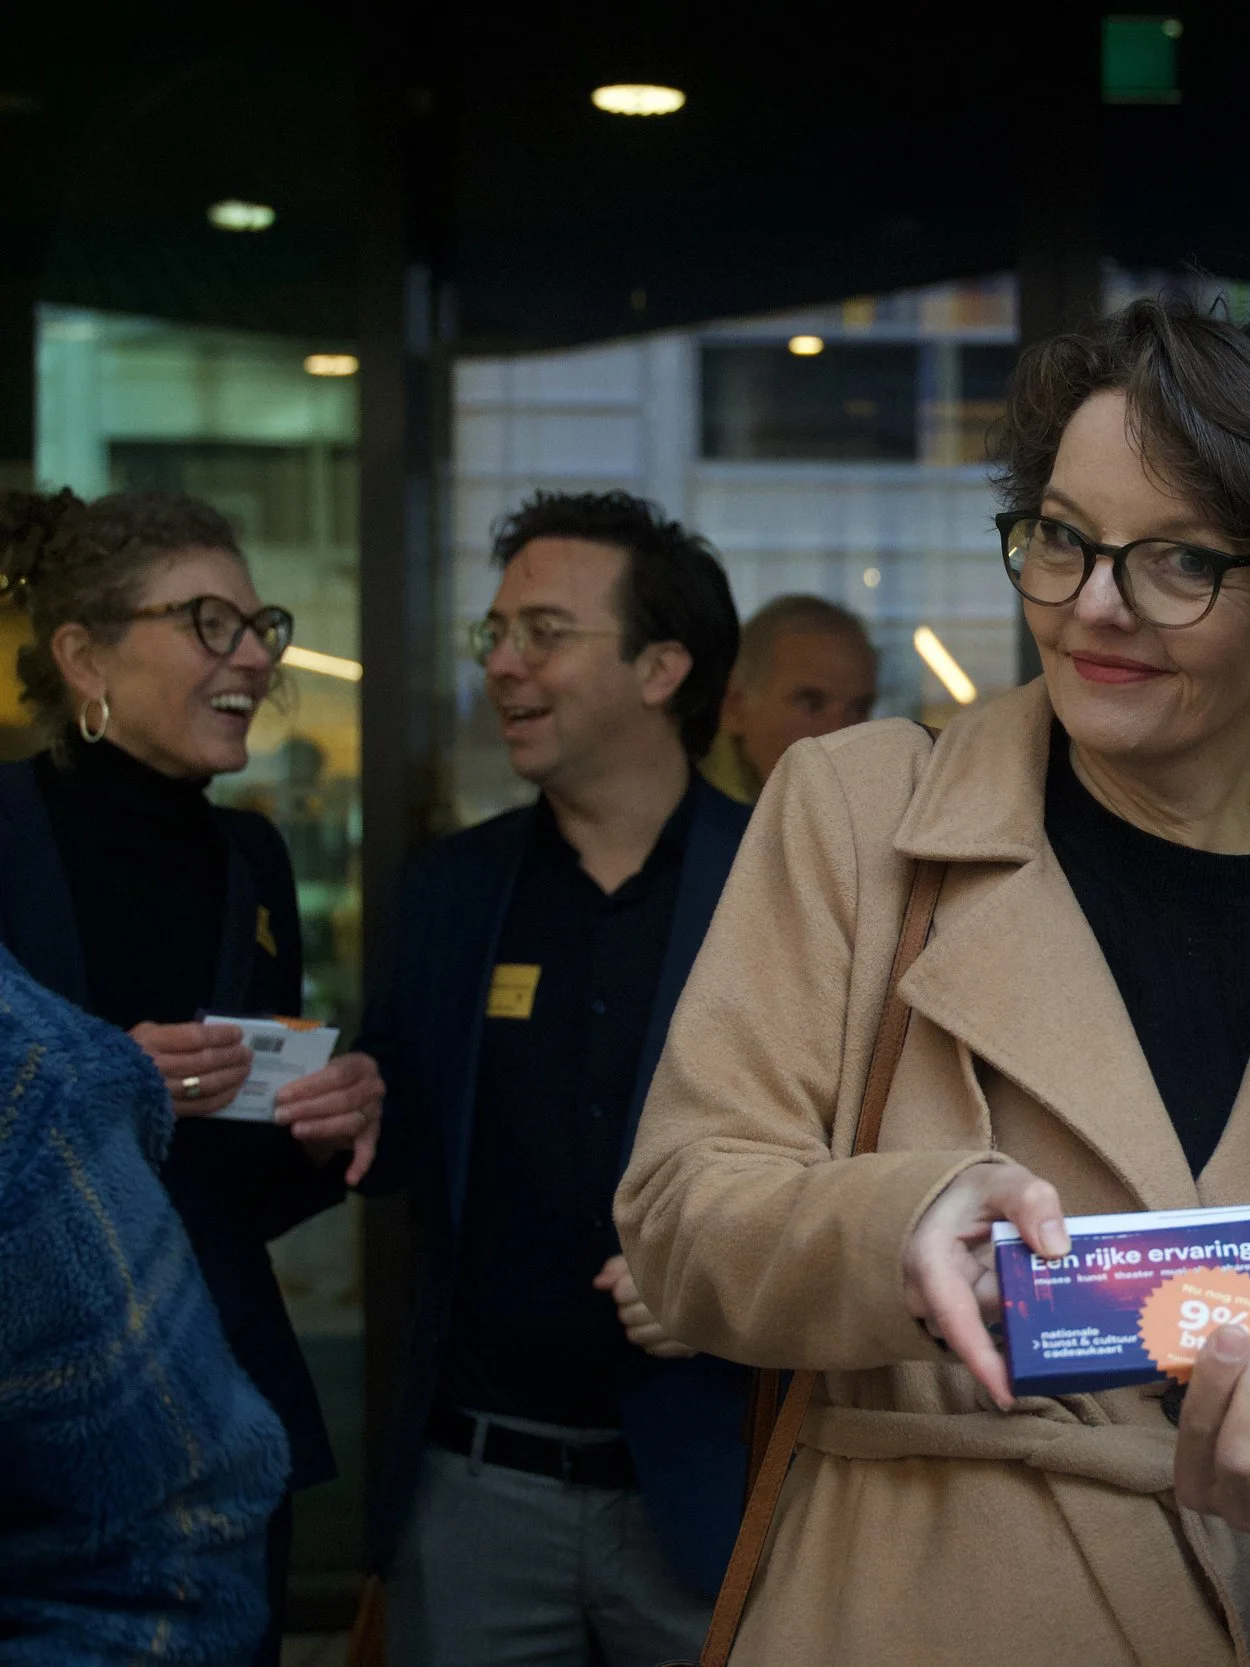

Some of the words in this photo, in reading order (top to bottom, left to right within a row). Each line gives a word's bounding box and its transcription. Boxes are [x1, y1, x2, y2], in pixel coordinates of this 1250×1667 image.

[1085, 1246, 1142, 1271] rijke
[1113, 1268, 1155, 1281] theater
[1203, 1289, 1232, 1305] nog
[1040, 1326, 1100, 1340] nationale
[1041, 1337, 1078, 1349] kunst
[1079, 1336, 1090, 1347] &
[1092, 1334, 1138, 1346] cultuur
[1043, 1344, 1123, 1359] cadeaukaart
